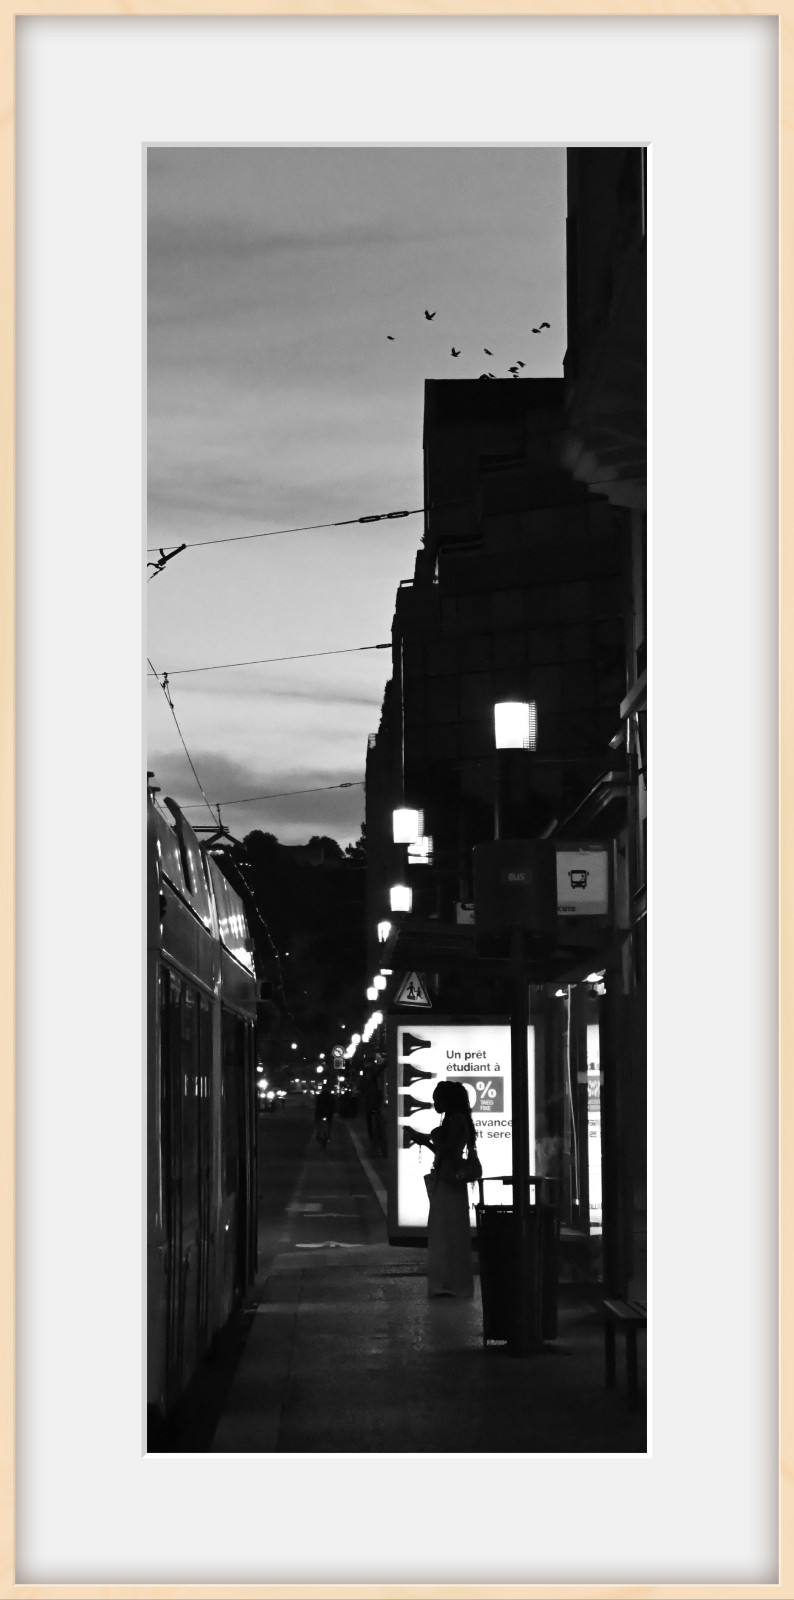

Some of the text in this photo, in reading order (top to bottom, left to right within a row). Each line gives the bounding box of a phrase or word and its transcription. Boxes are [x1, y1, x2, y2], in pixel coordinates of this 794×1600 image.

[508, 872, 525, 881] BUS
[446, 1050, 487, 1061] Un prêt
[446, 1062, 501, 1072] étudiant à
